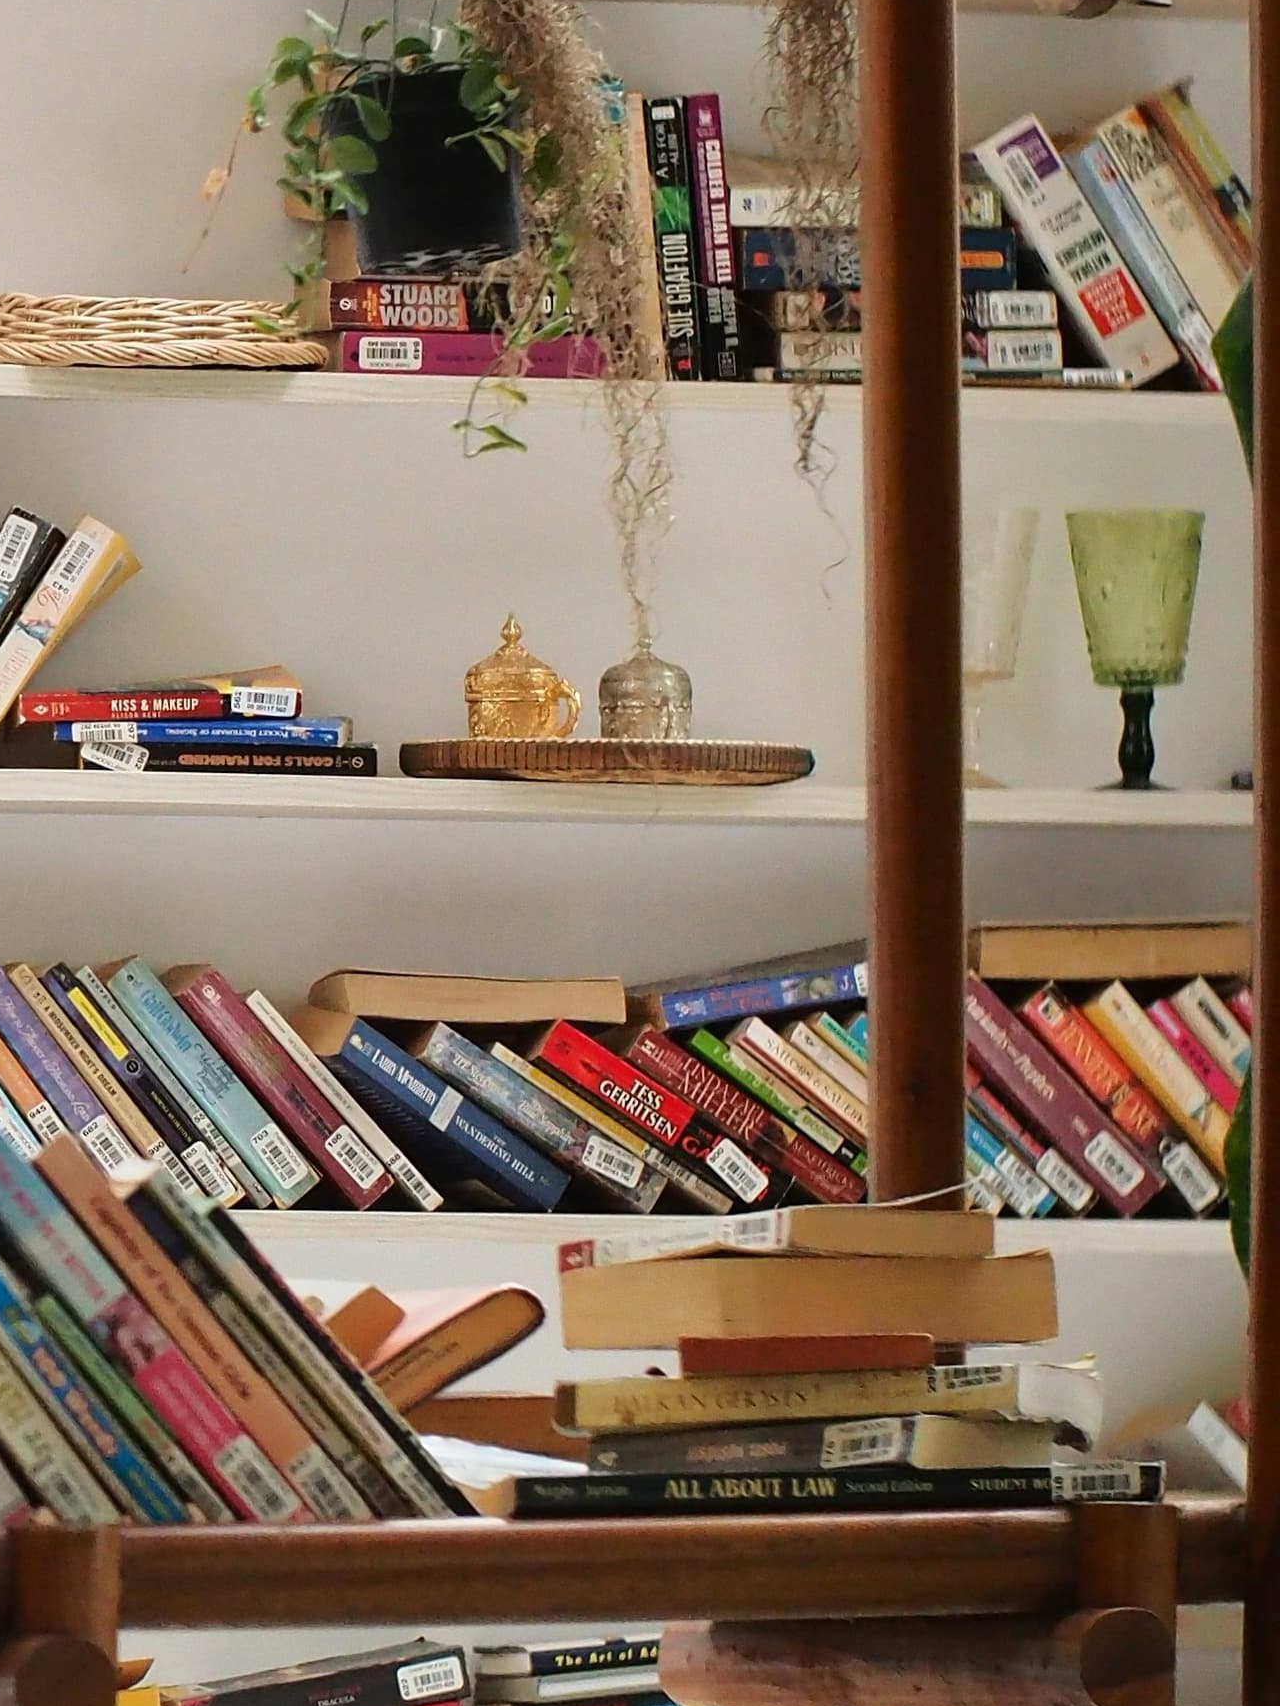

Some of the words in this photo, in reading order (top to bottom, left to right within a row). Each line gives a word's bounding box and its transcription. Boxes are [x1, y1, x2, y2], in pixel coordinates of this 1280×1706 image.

[660, 233, 691, 304] GRAFTON
[380, 283, 459, 305] STUART
[379, 305, 461, 327] WOODS
[668, 307, 693, 339] SUE
[111, 699, 138, 712] KISS
[140, 700, 150, 711] &
[152, 698, 199, 711] MAKEUP
[631, 1078, 665, 1110] TESS
[599, 1078, 679, 1142] GERRITSEN
[454, 1114, 513, 1166] WANDERING
[510, 1157, 535, 1183] HILL
[664, 1478, 704, 1500] ALL
[707, 1477, 785, 1499] ABOUT
[790, 1476, 837, 1497] LAW
[845, 1480, 887, 1493] Second
[970, 1477, 1029, 1490] STUDENT
[554, 1651, 582, 1667] The
[587, 1649, 614, 1665] Art
[618, 1648, 635, 1664] of
